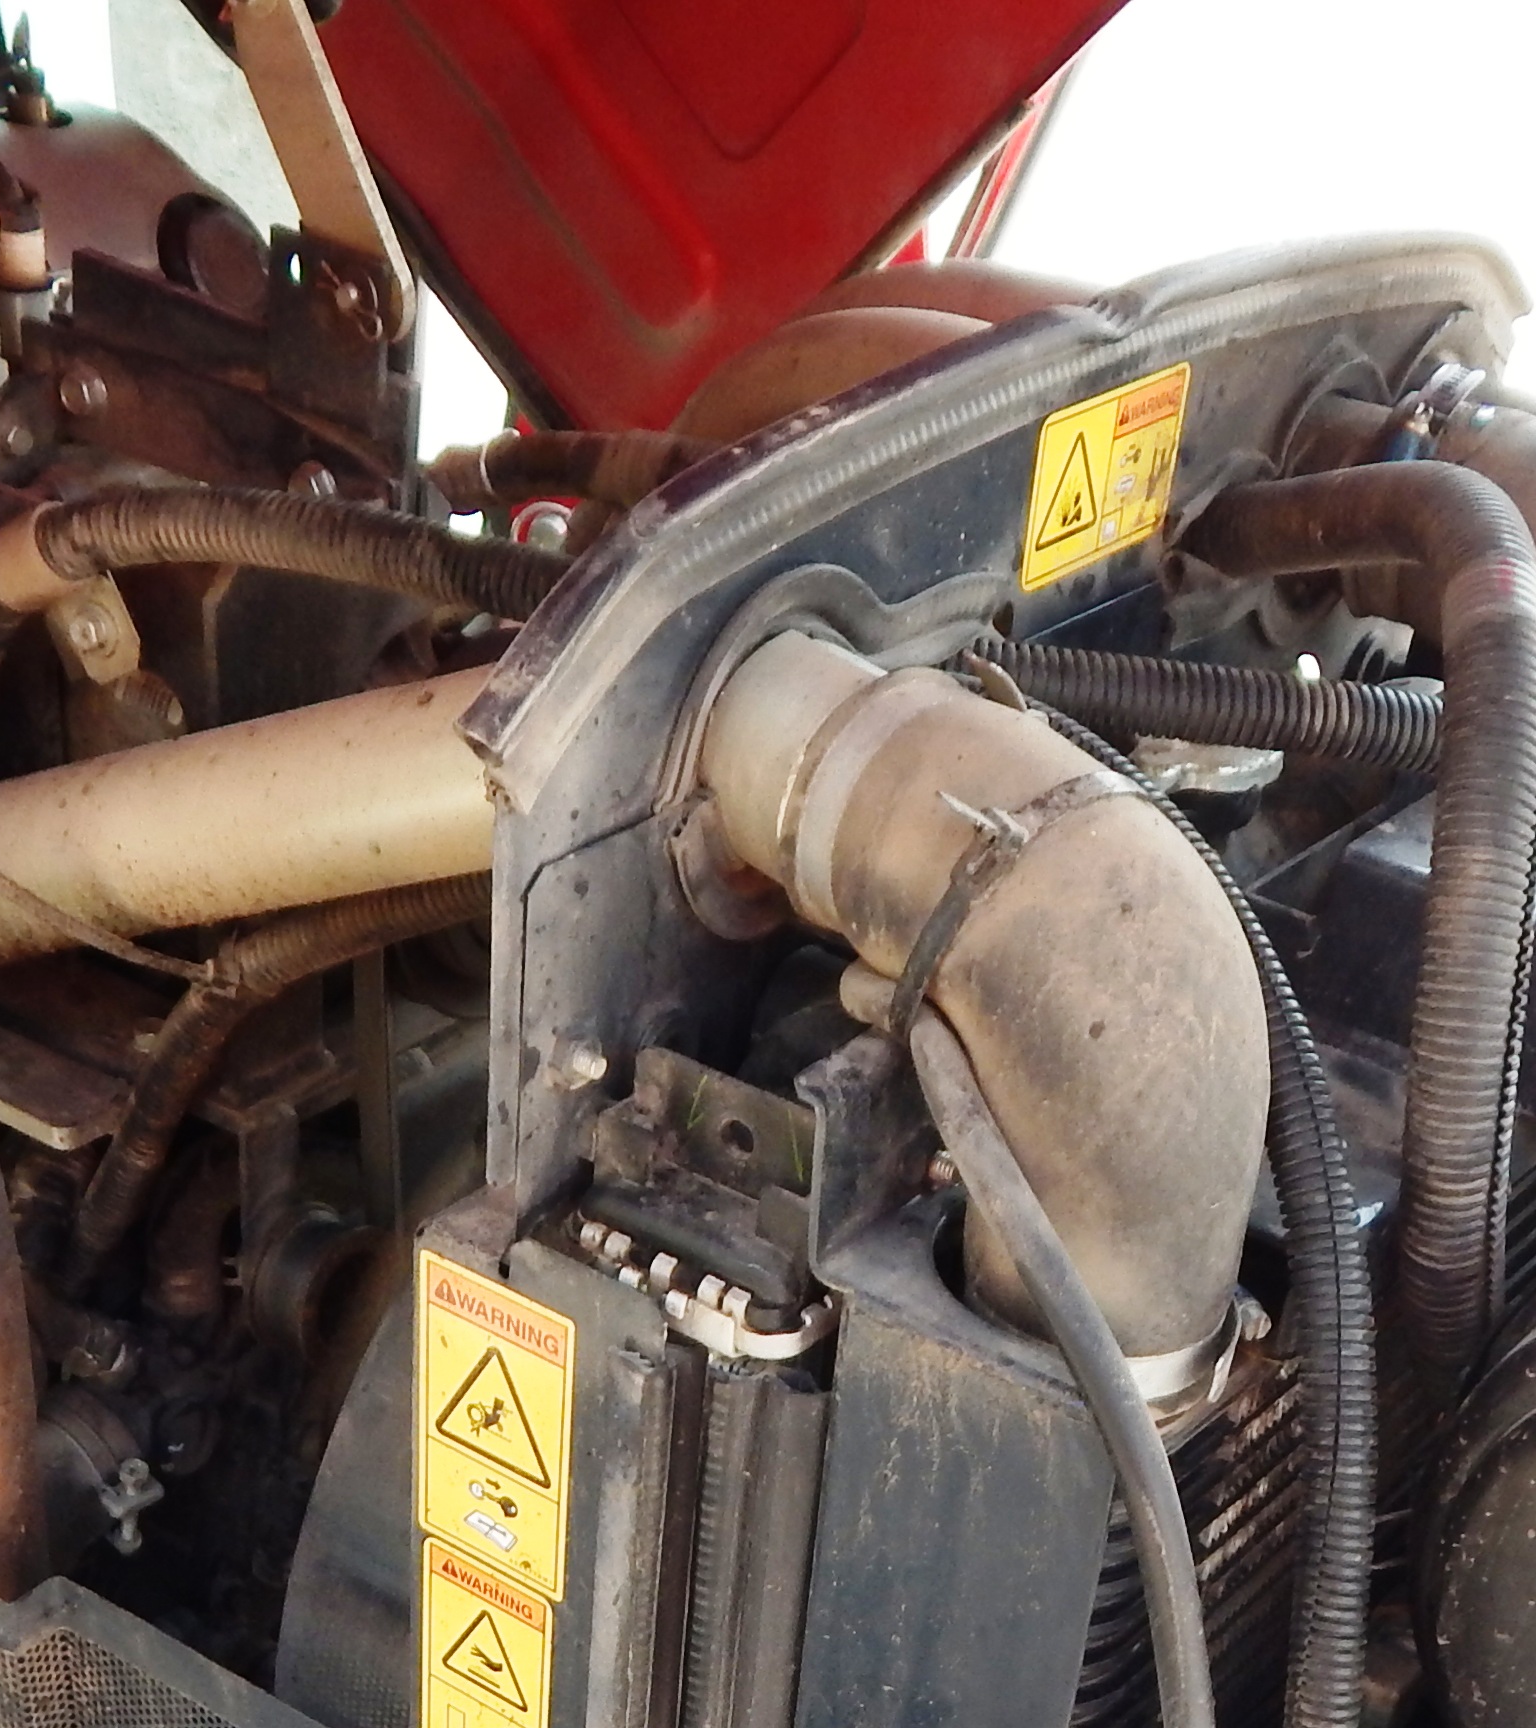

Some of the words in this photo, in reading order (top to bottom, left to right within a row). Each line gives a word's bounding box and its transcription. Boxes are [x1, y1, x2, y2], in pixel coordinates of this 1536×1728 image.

[1130, 385, 1182, 421] WARNING
[455, 1294, 559, 1357] WARNING
[457, 1570, 533, 1622] WARNING
